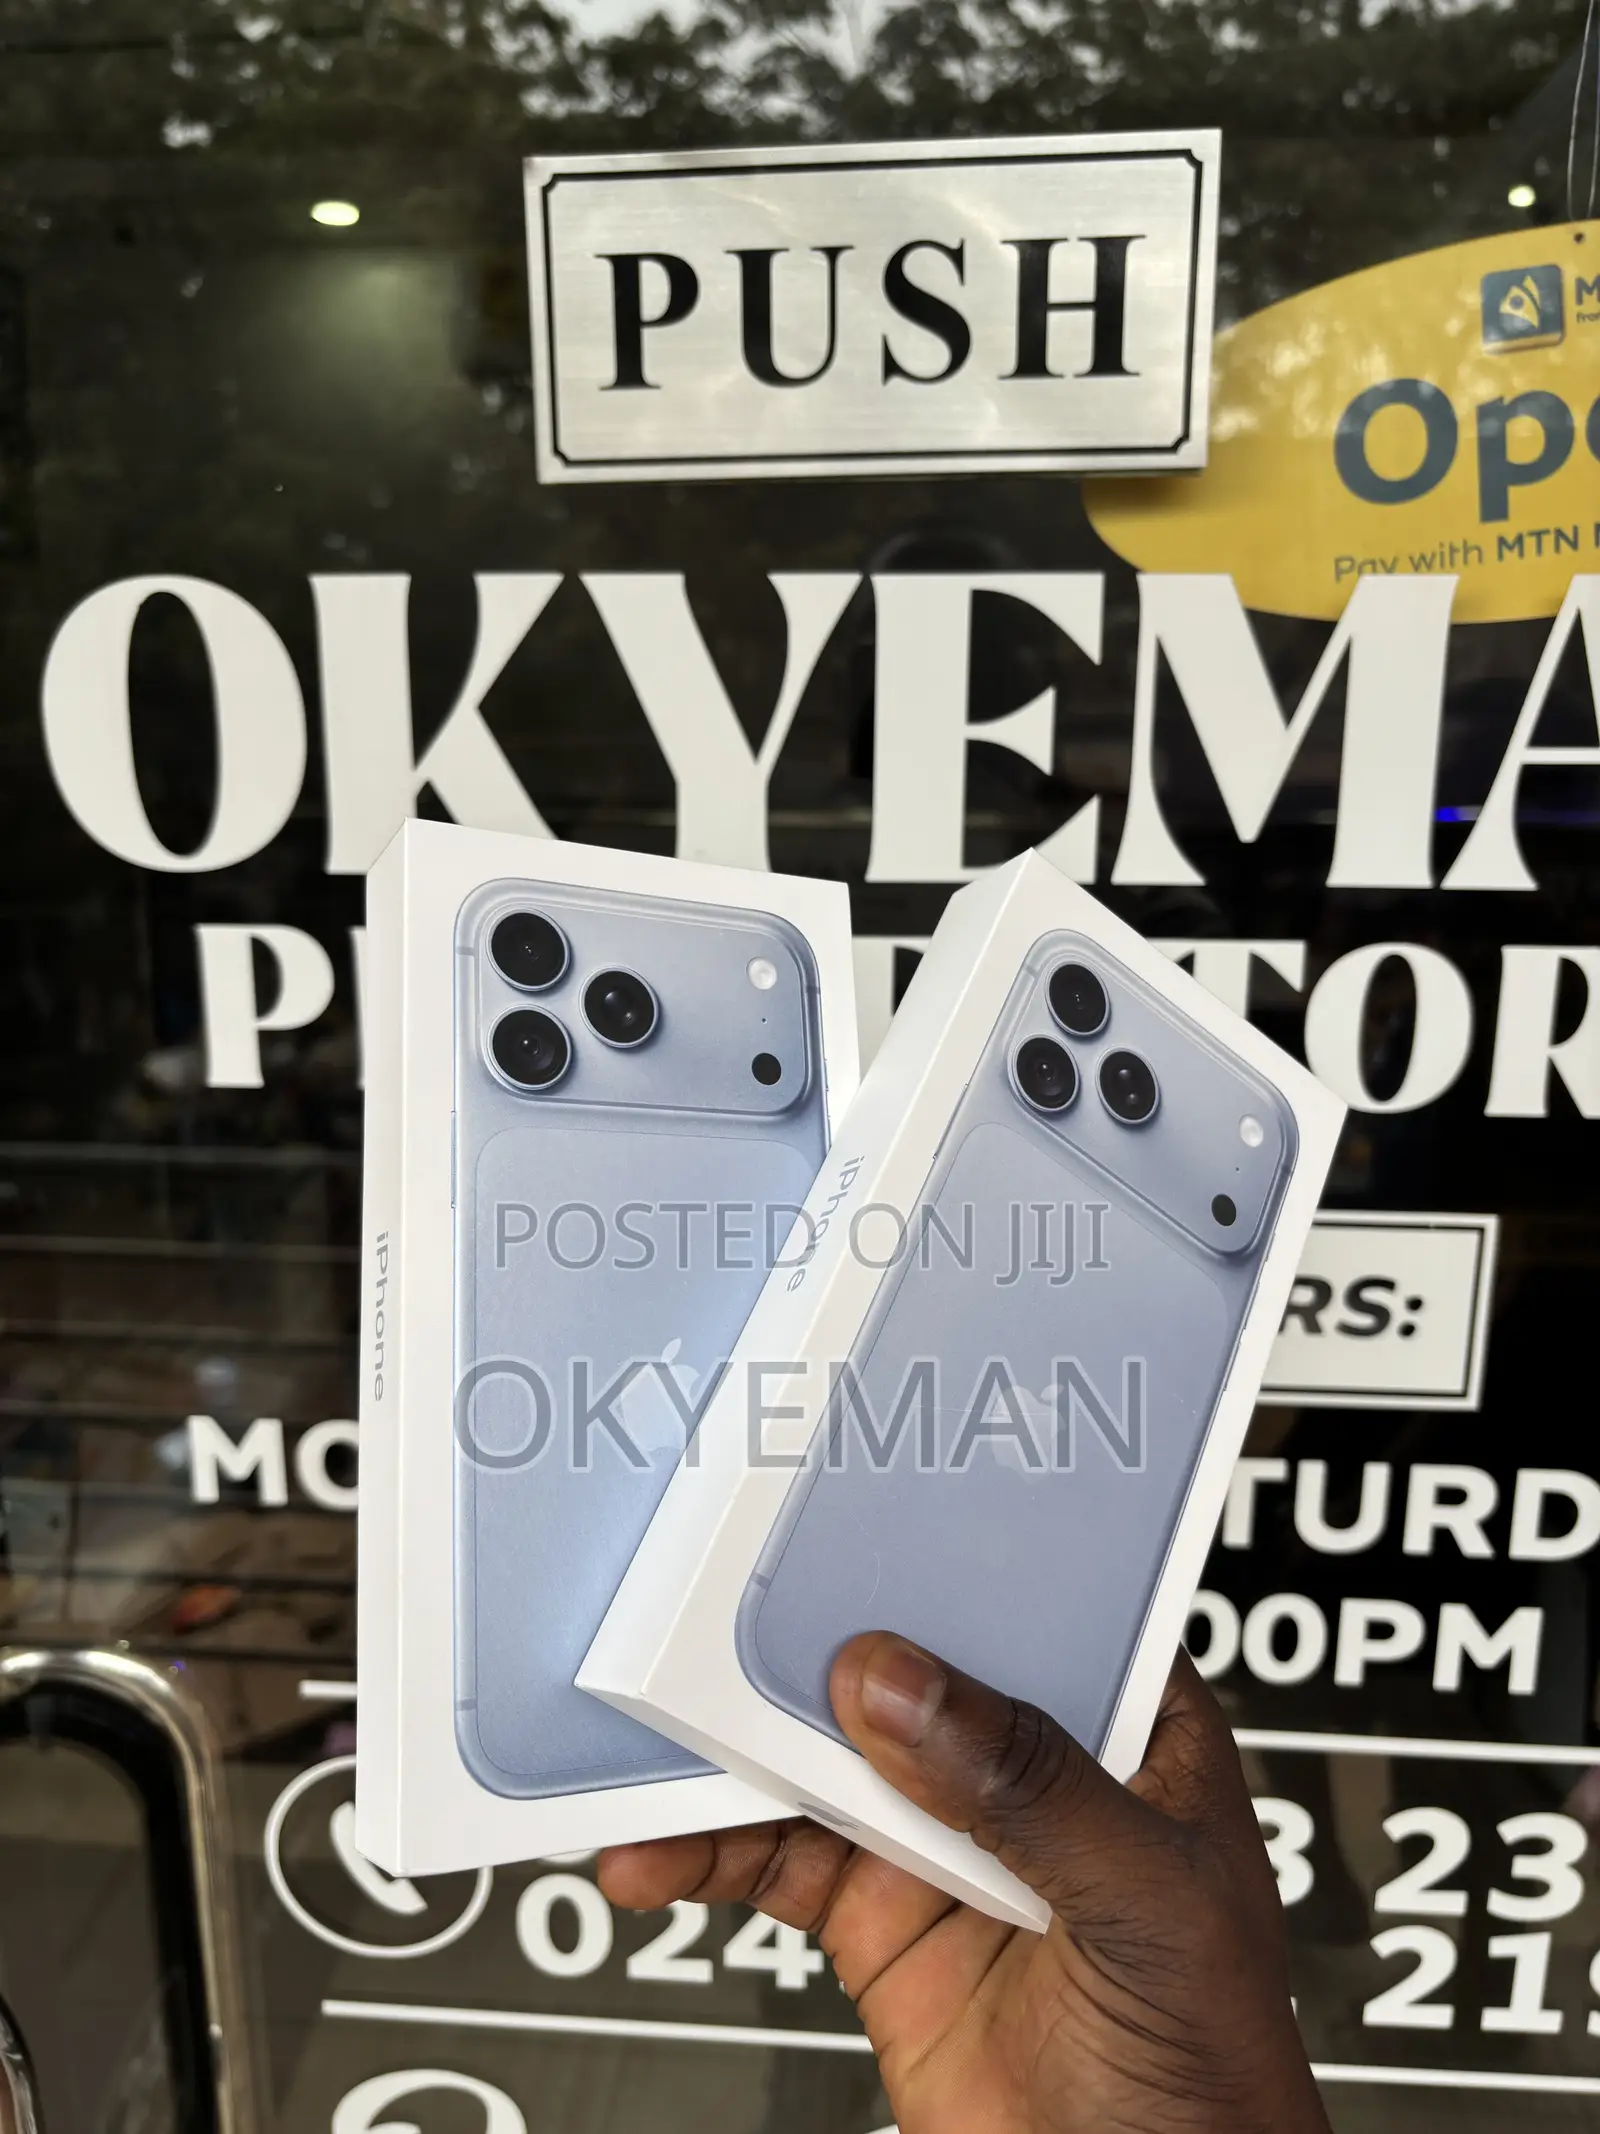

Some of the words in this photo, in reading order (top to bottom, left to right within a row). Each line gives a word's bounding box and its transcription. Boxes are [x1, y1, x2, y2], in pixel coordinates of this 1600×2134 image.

[594, 235, 1147, 391] PUSH
[1333, 377, 1600, 524] Op
[1409, 539, 1484, 572] with
[1497, 525, 1580, 563] MTN
[786, 1155, 865, 1292] iPhone
[374, 1230, 389, 1402] iPhone
